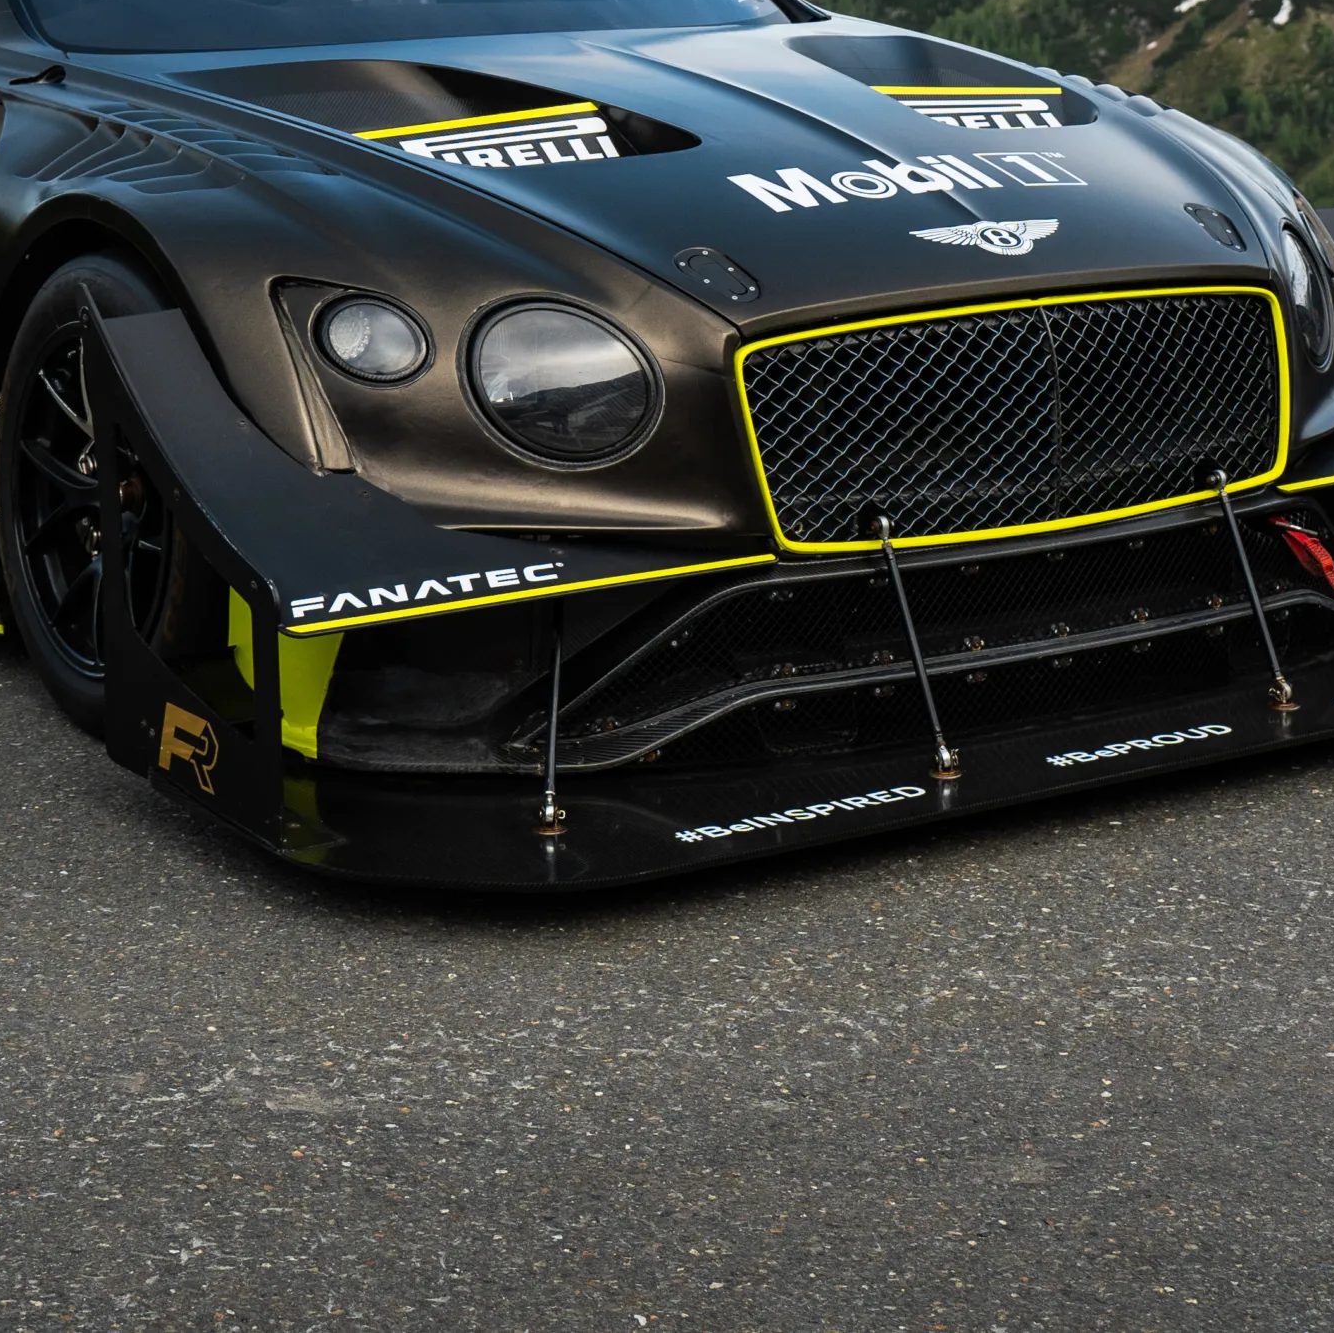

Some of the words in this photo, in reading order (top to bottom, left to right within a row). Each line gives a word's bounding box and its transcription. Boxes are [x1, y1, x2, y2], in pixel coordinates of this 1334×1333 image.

[726, 153, 1005, 213] Mobil
[289, 562, 560, 619] FANATEC
[1045, 724, 1234, 767] #BePROUD
[674, 785, 927, 844] #BeINSPIRED
